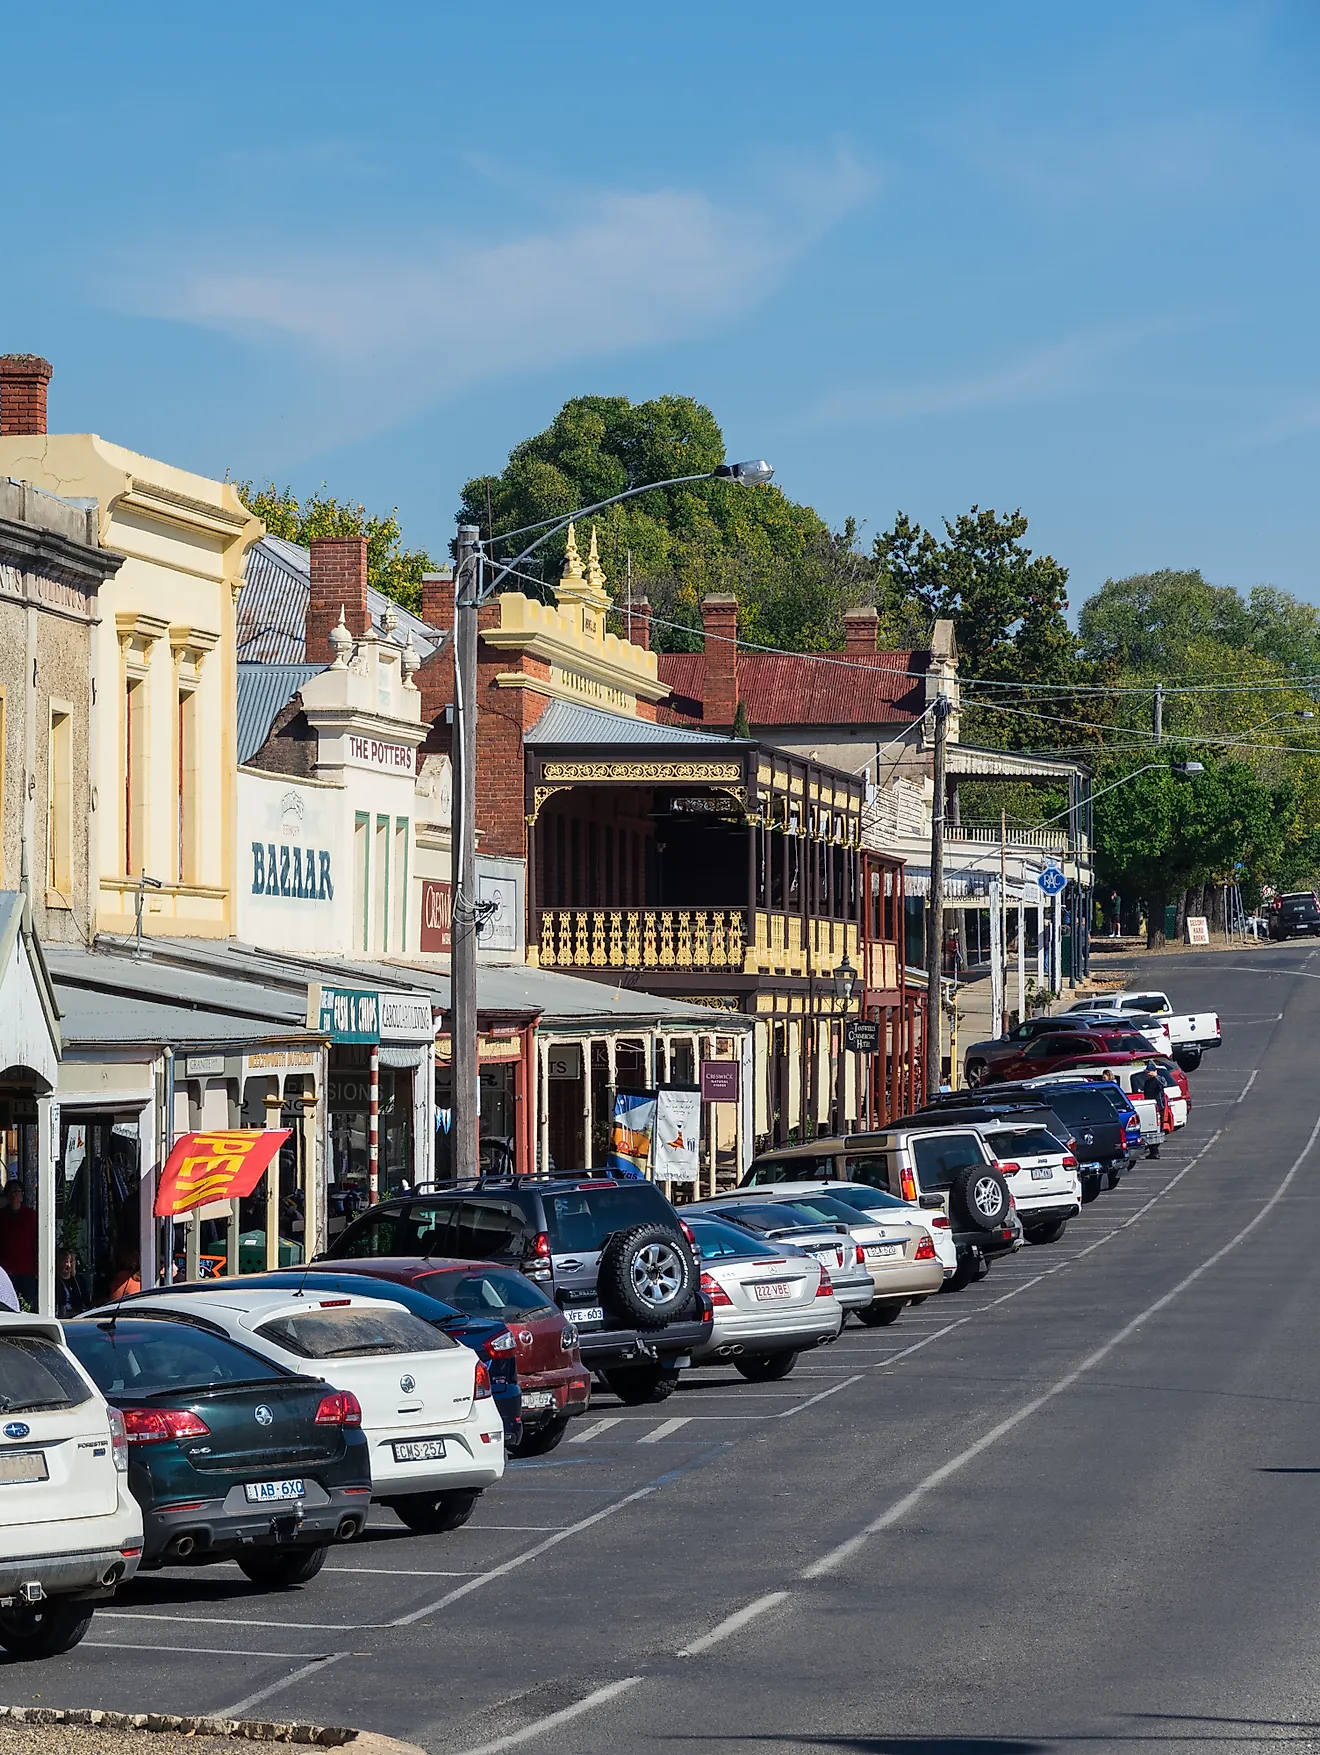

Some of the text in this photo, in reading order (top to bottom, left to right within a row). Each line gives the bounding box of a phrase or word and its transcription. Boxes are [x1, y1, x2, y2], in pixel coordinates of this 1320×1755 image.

[349, 736, 412, 770] THE POTTERS
[251, 841, 334, 901] BAZAAR
[333, 995, 349, 1032] FISH
[358, 996, 377, 1033] CHIPS
[77, 1440, 109, 1450] FORESTER
